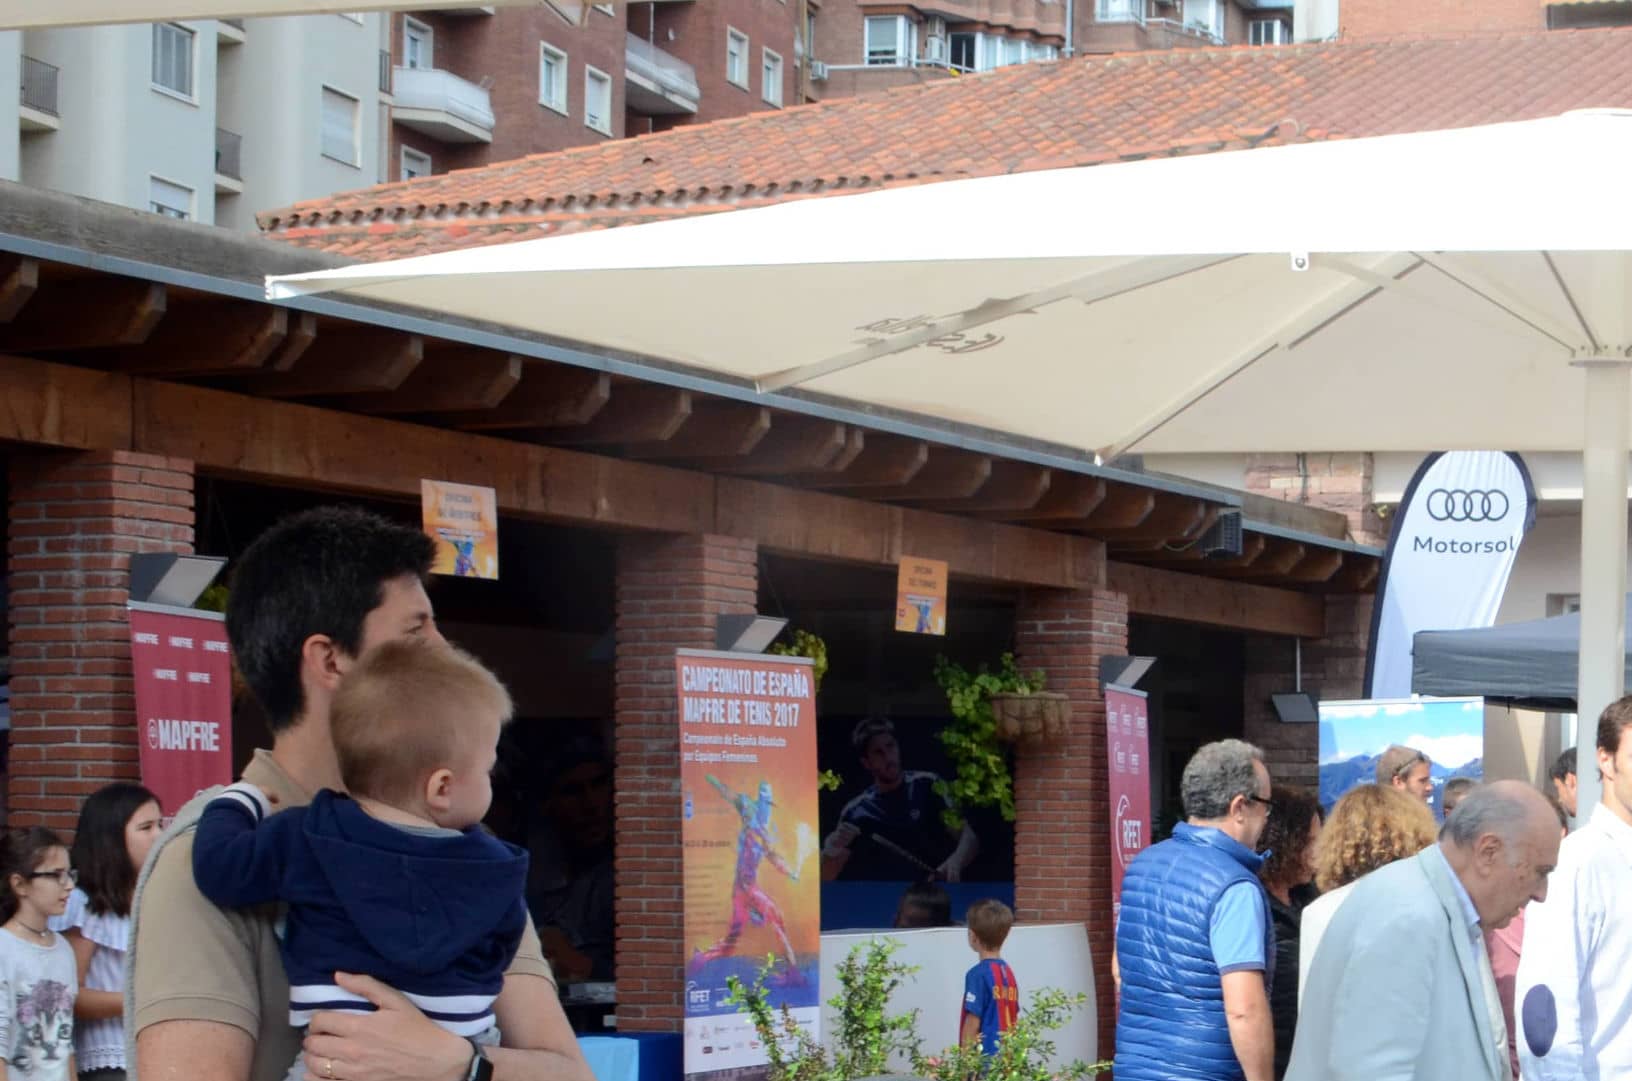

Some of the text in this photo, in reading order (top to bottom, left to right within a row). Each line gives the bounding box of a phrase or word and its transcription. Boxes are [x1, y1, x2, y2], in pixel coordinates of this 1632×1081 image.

[1413, 535, 1514, 554] Motorsol
[682, 665, 809, 699] CAMPEONATO DE ESPAÑA
[683, 696, 799, 728] MAPFRE DE TENIS 2017
[158, 719, 220, 752] MAPFRE
[1122, 819, 1142, 849] RFET
